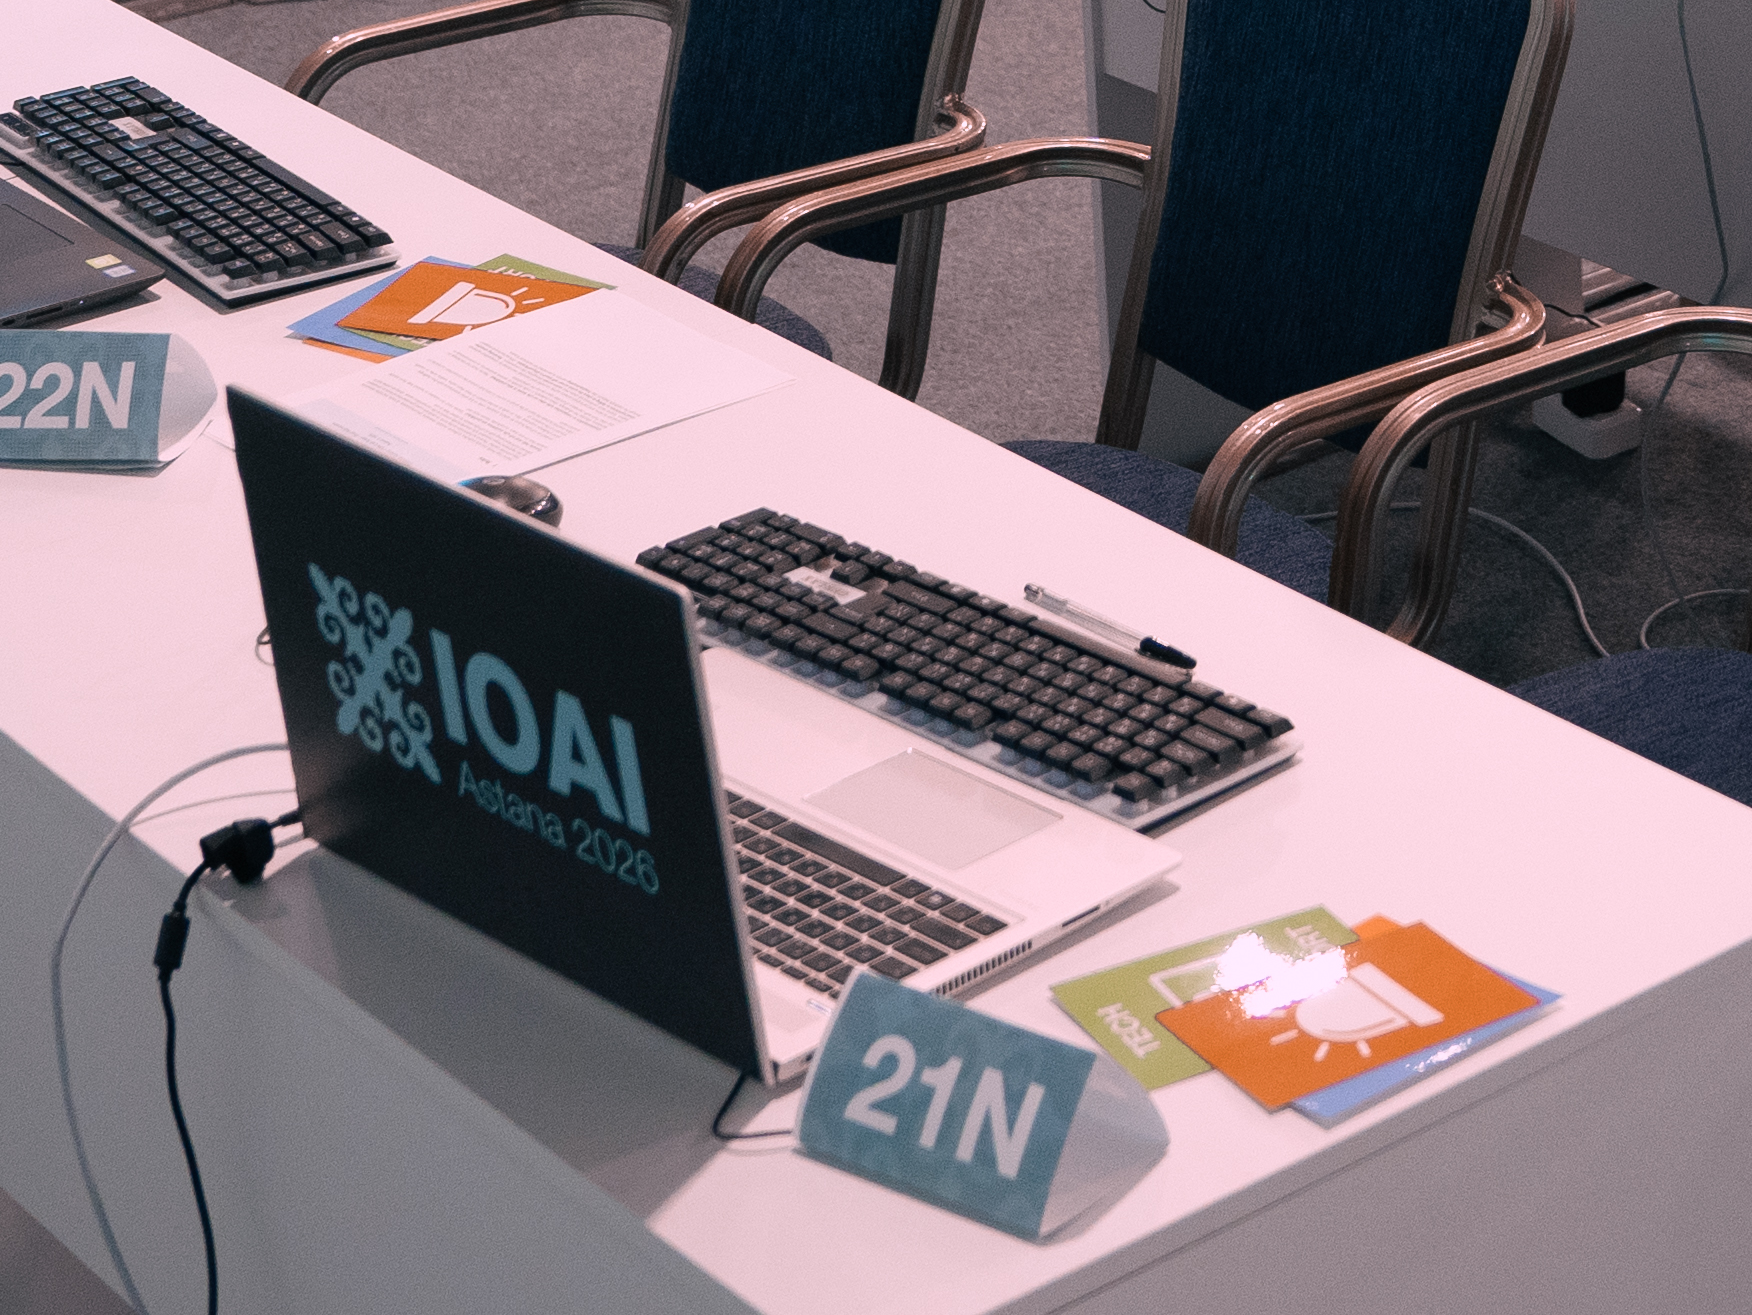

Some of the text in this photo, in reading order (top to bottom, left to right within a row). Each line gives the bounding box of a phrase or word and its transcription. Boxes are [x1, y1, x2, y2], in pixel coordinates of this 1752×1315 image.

[429, 627, 650, 837] IOAI
[458, 760, 660, 895] Astana 2026
[844, 1033, 1046, 1181] 21N
